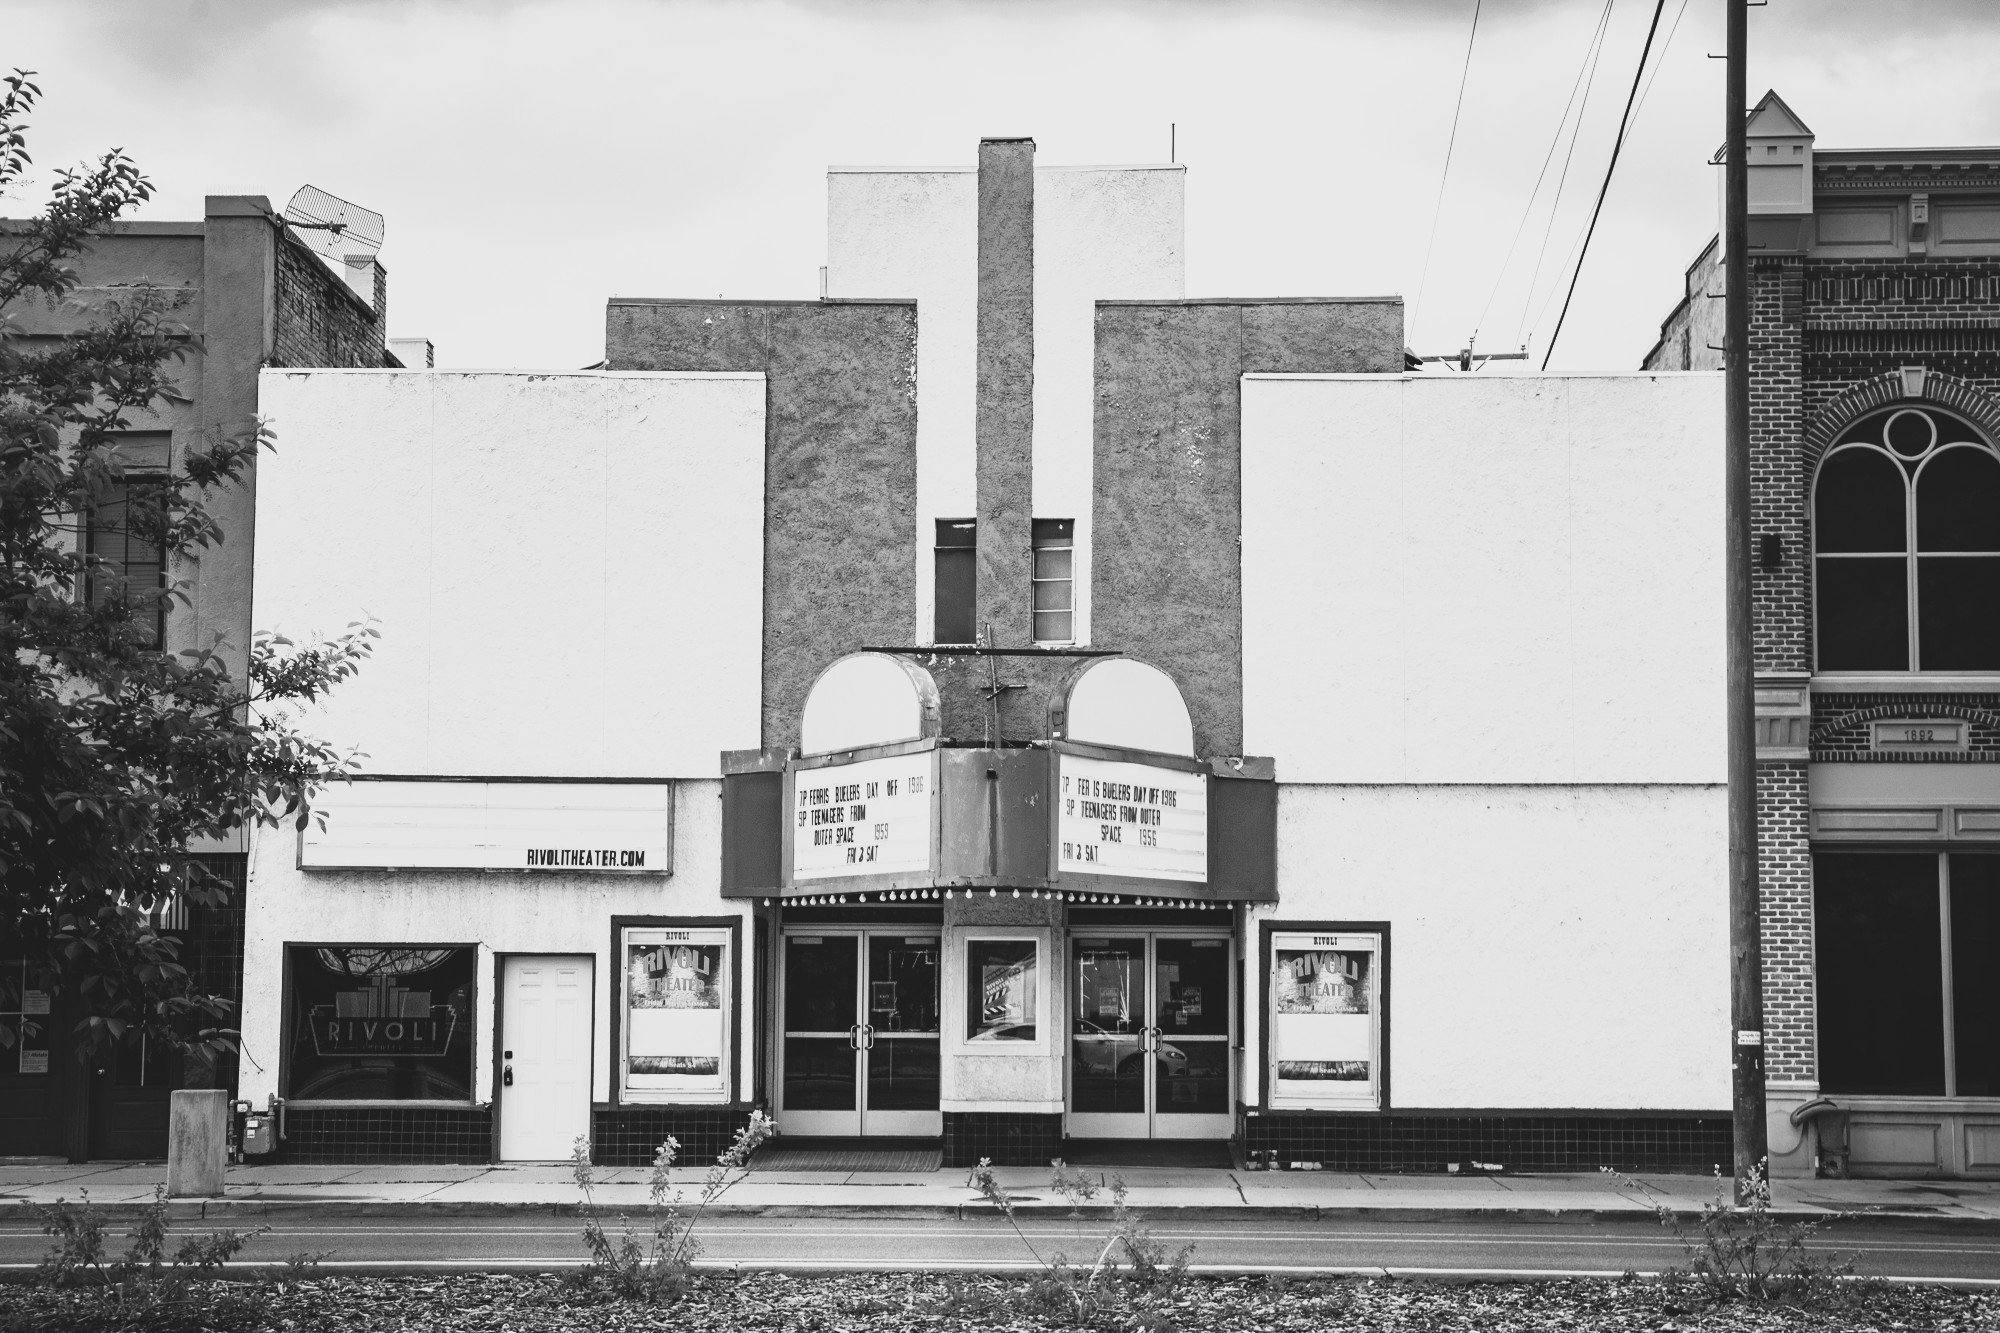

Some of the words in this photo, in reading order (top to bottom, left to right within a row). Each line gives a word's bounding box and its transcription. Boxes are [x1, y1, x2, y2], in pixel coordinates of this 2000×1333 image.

[1904, 730, 1934, 742] 1892
[799, 790, 808, 806] 7P
[809, 788, 830, 806] FERRIS
[835, 784, 860, 803] BUELERS
[866, 782, 878, 799] DAY
[886, 779, 898, 796] OFF
[908, 776, 924, 794] 1986
[1062, 776, 1070, 793] 7P
[1102, 782, 1130, 802] BUELERS
[1134, 786, 1147, 803] DAY
[1148, 788, 1159, 805] OFF
[1162, 790, 1177, 807] 1986
[798, 811, 806, 827] 9P
[811, 807, 844, 826] TEENAGERS
[850, 804, 866, 822] FROM
[1066, 798, 1074, 816] 9P
[1080, 801, 1116, 820] TEENAGERS
[1120, 806, 1138, 823] FROM
[1140, 808, 1160, 826] OUTER
[814, 829, 832, 846] OUTER
[836, 826, 854, 844] SPACE
[874, 823, 888, 840] 1959
[1101, 824, 1122, 843] SPACE
[1140, 828, 1156, 846] 1956
[527, 848, 645, 866] RIVOLITHEATER.COM
[846, 848, 856, 864] FRI
[866, 845, 878, 862] SAT
[1063, 842, 1073, 860] FRI
[1086, 845, 1098, 862] SAT
[666, 932, 690, 940] RIVOLI
[1313, 936, 1338, 946] RIVOLI
[642, 946, 709, 976] RIVOLI
[1290, 952, 1358, 980] RIVOLI
[650, 978, 704, 992] THEATER
[1299, 982, 1354, 998] THEATER
[328, 1022, 437, 1041] RIVOLI
